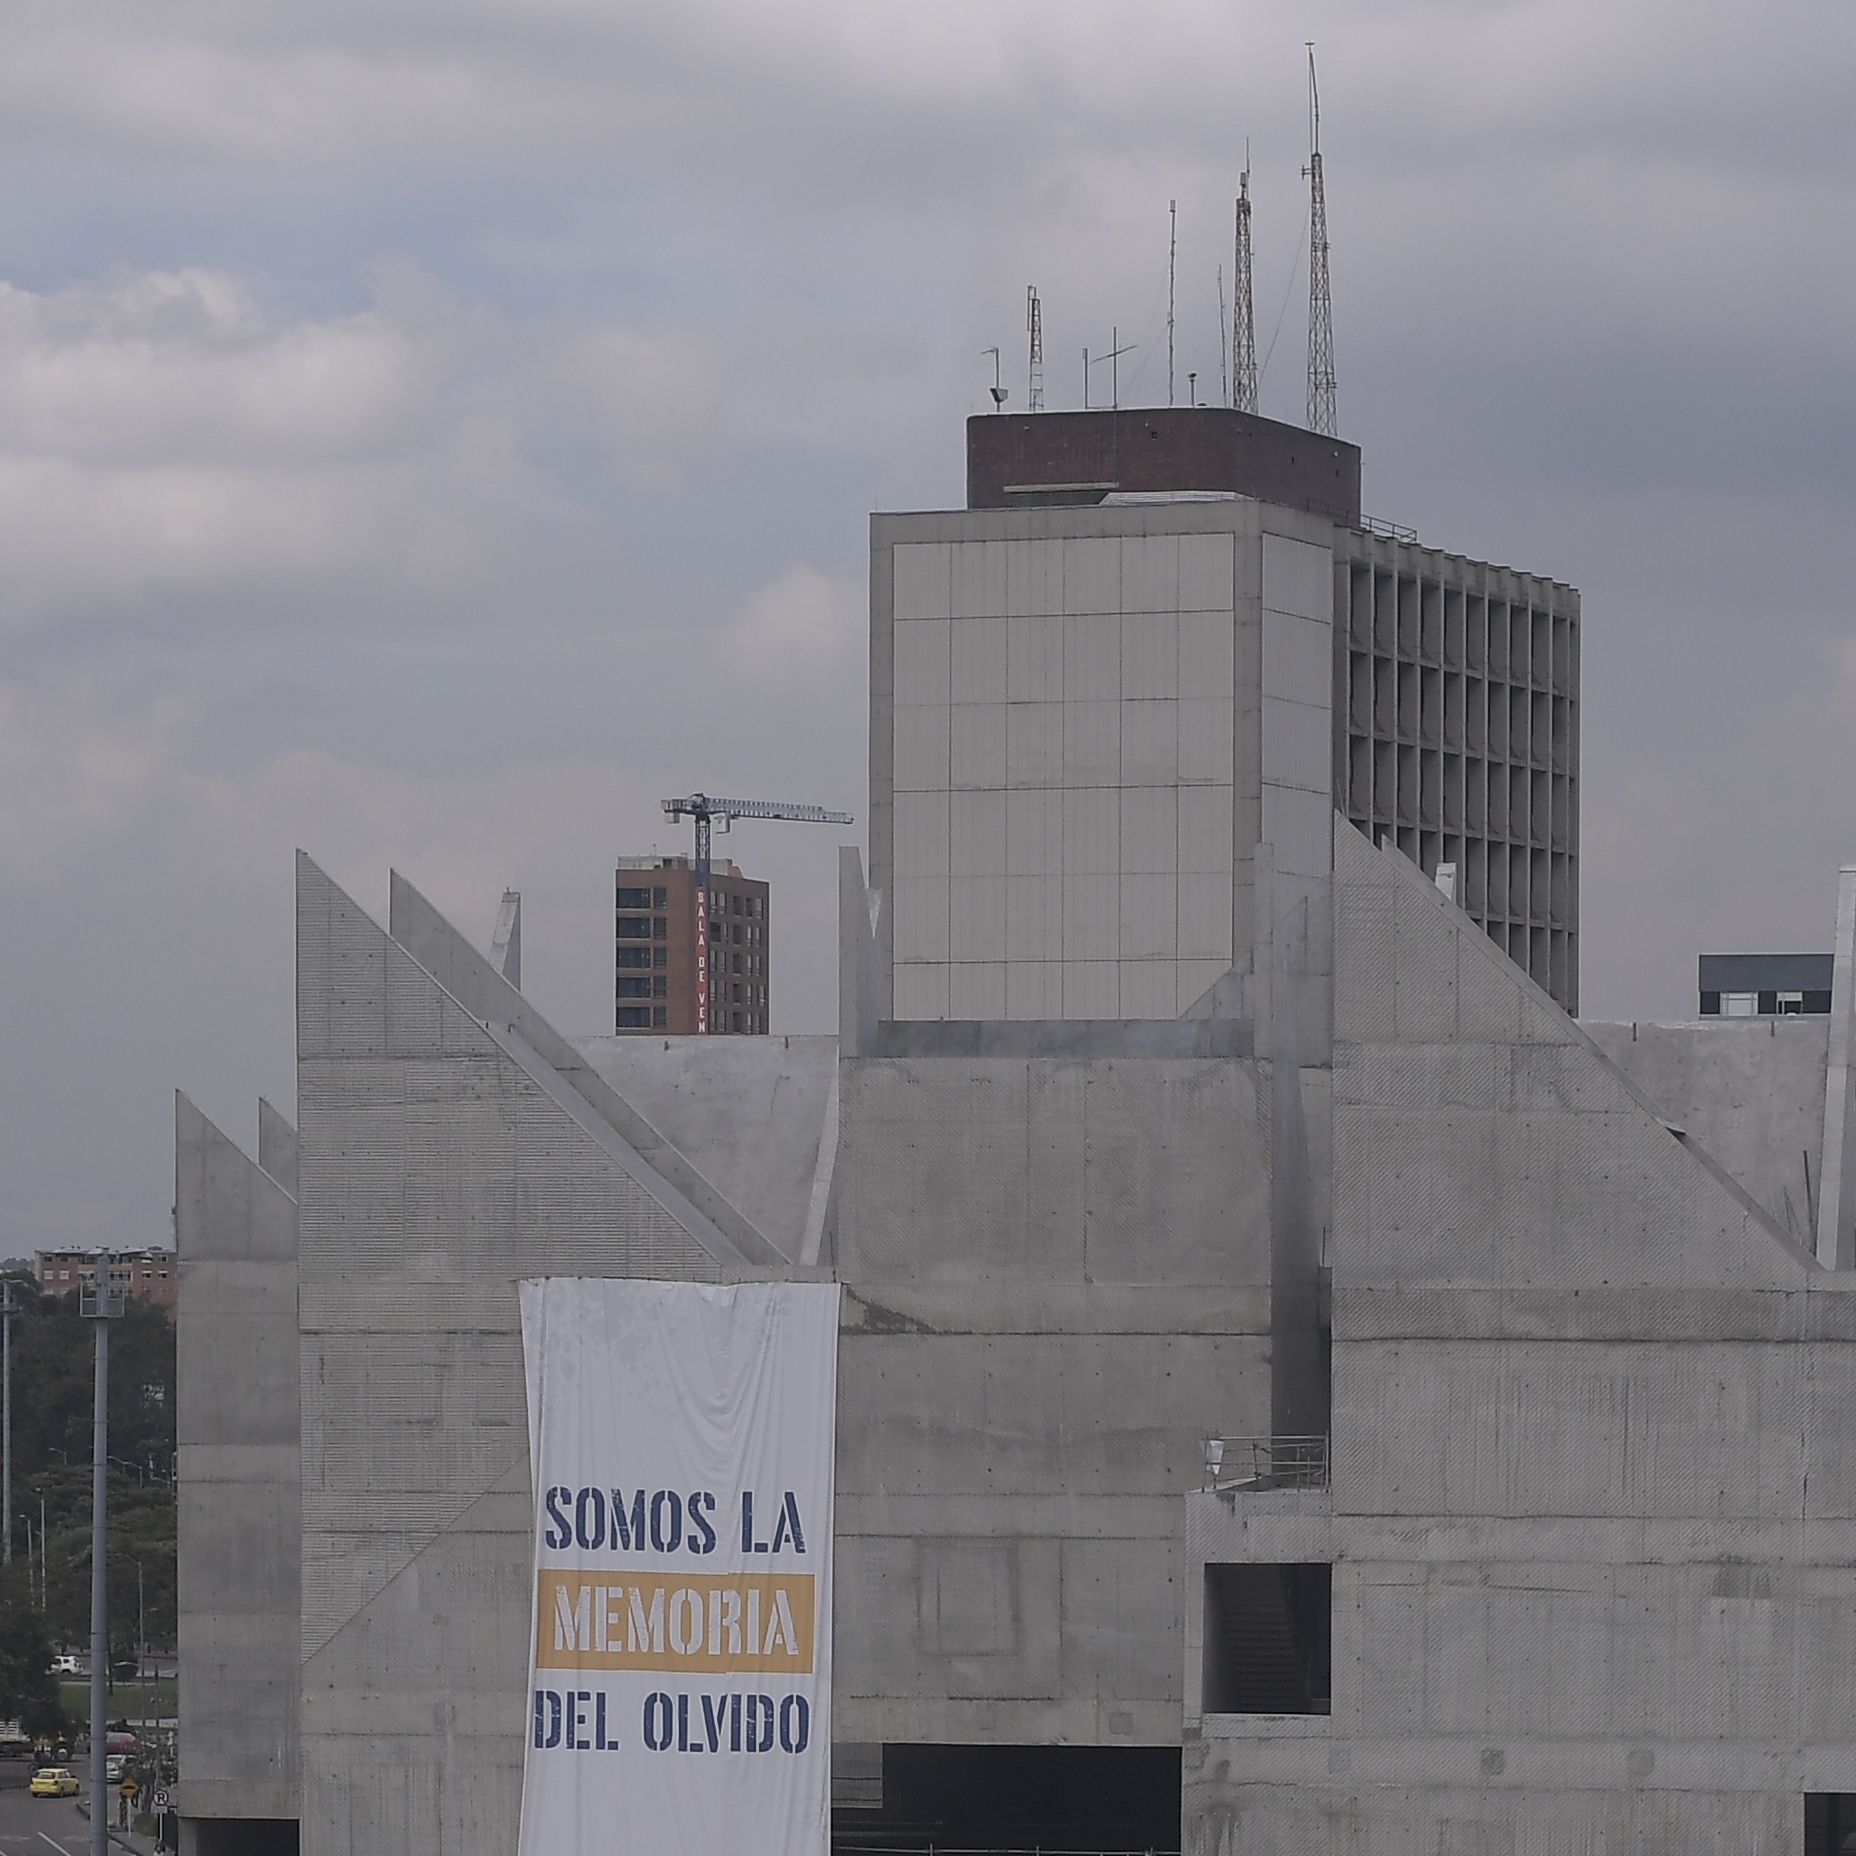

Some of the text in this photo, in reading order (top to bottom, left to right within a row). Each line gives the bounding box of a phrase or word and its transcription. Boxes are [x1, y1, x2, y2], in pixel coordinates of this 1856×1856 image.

[544, 1486, 807, 1554] SOMOS LA
[553, 1584, 800, 1656] MEMORIA
[534, 1690, 811, 1755] DEL OLVIDO
